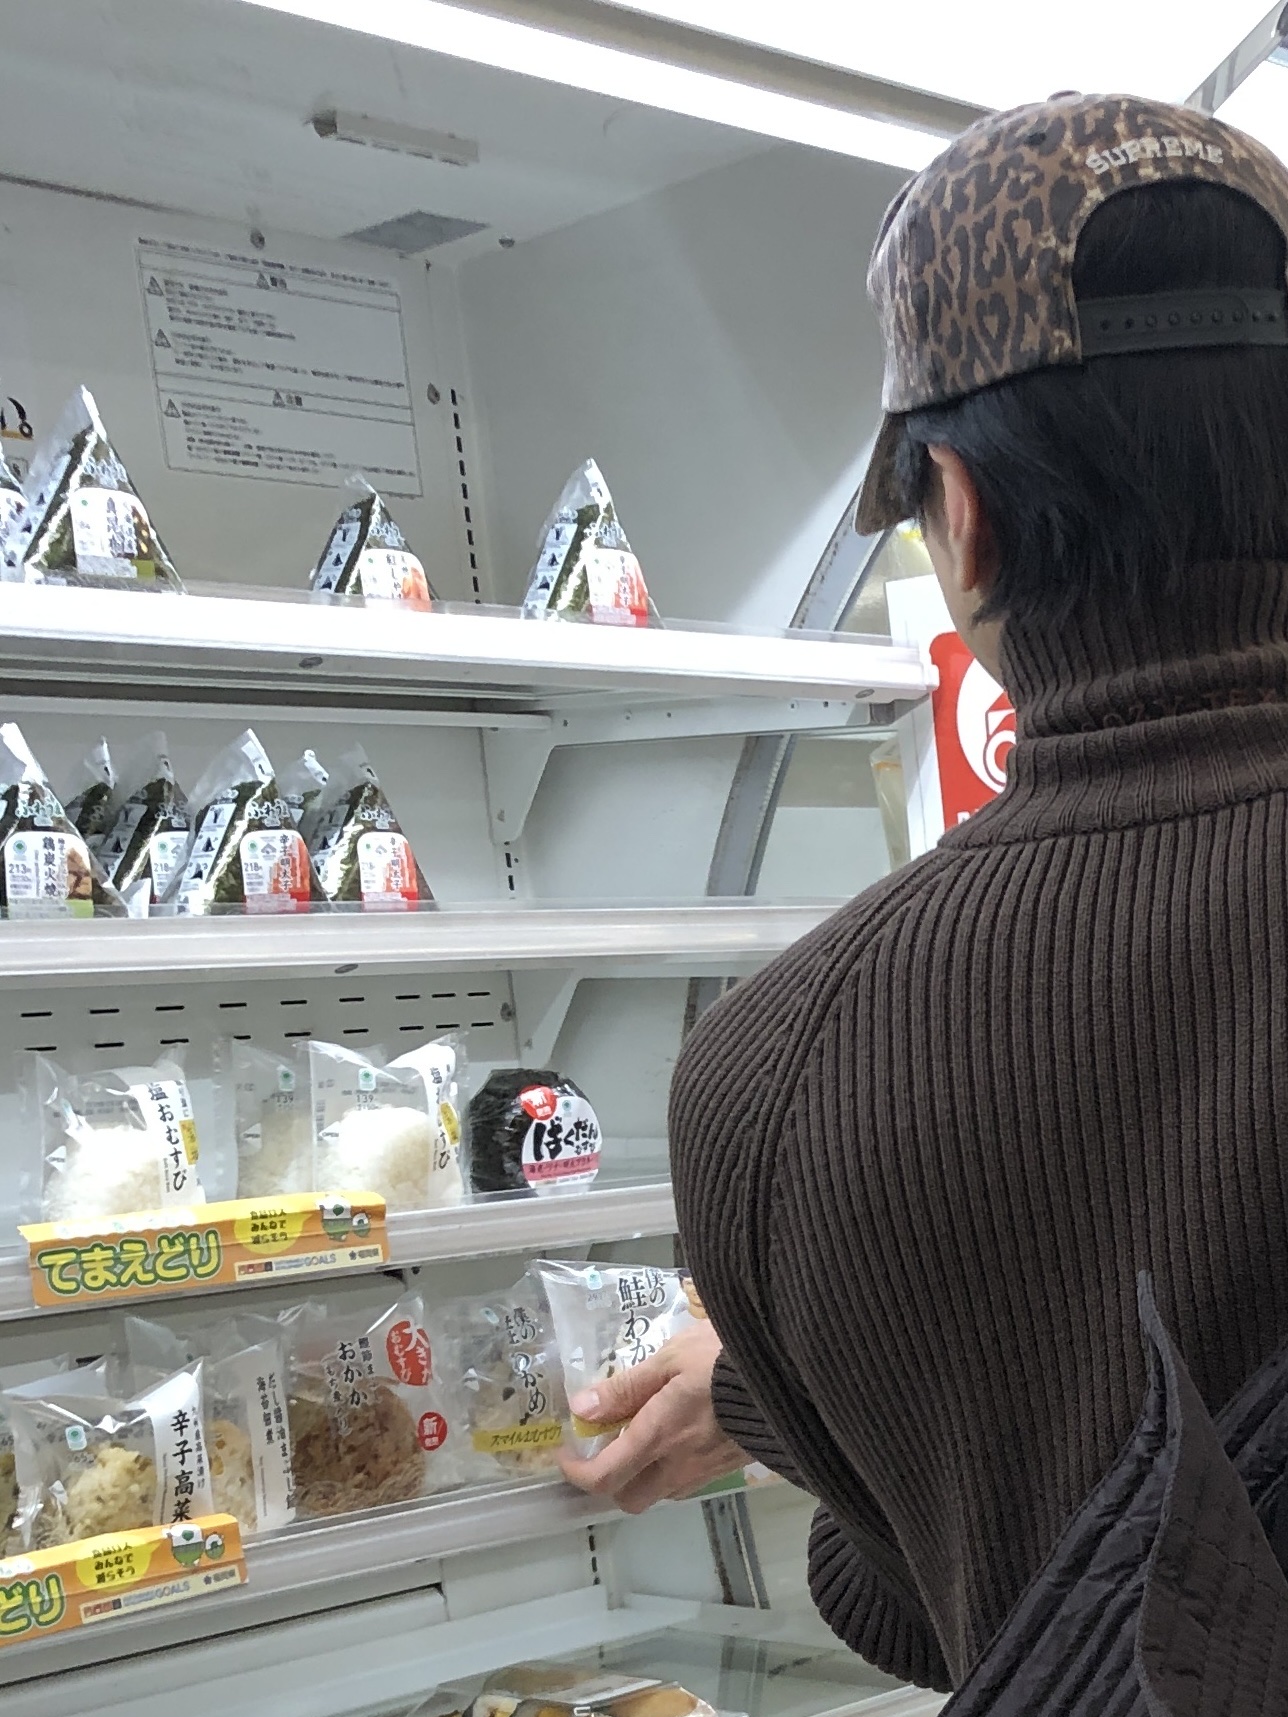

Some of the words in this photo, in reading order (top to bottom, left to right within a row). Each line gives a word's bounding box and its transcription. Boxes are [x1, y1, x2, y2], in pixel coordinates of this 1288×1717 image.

[1086, 136, 1224, 175] SUPREME
[149, 1083, 187, 1191] 塩おむすび
[533, 1115, 598, 1161] ばくだん
[38, 1230, 223, 1295] てまえどり
[337, 1341, 369, 1407] おかか
[170, 1409, 195, 1522] 辛子高菜
